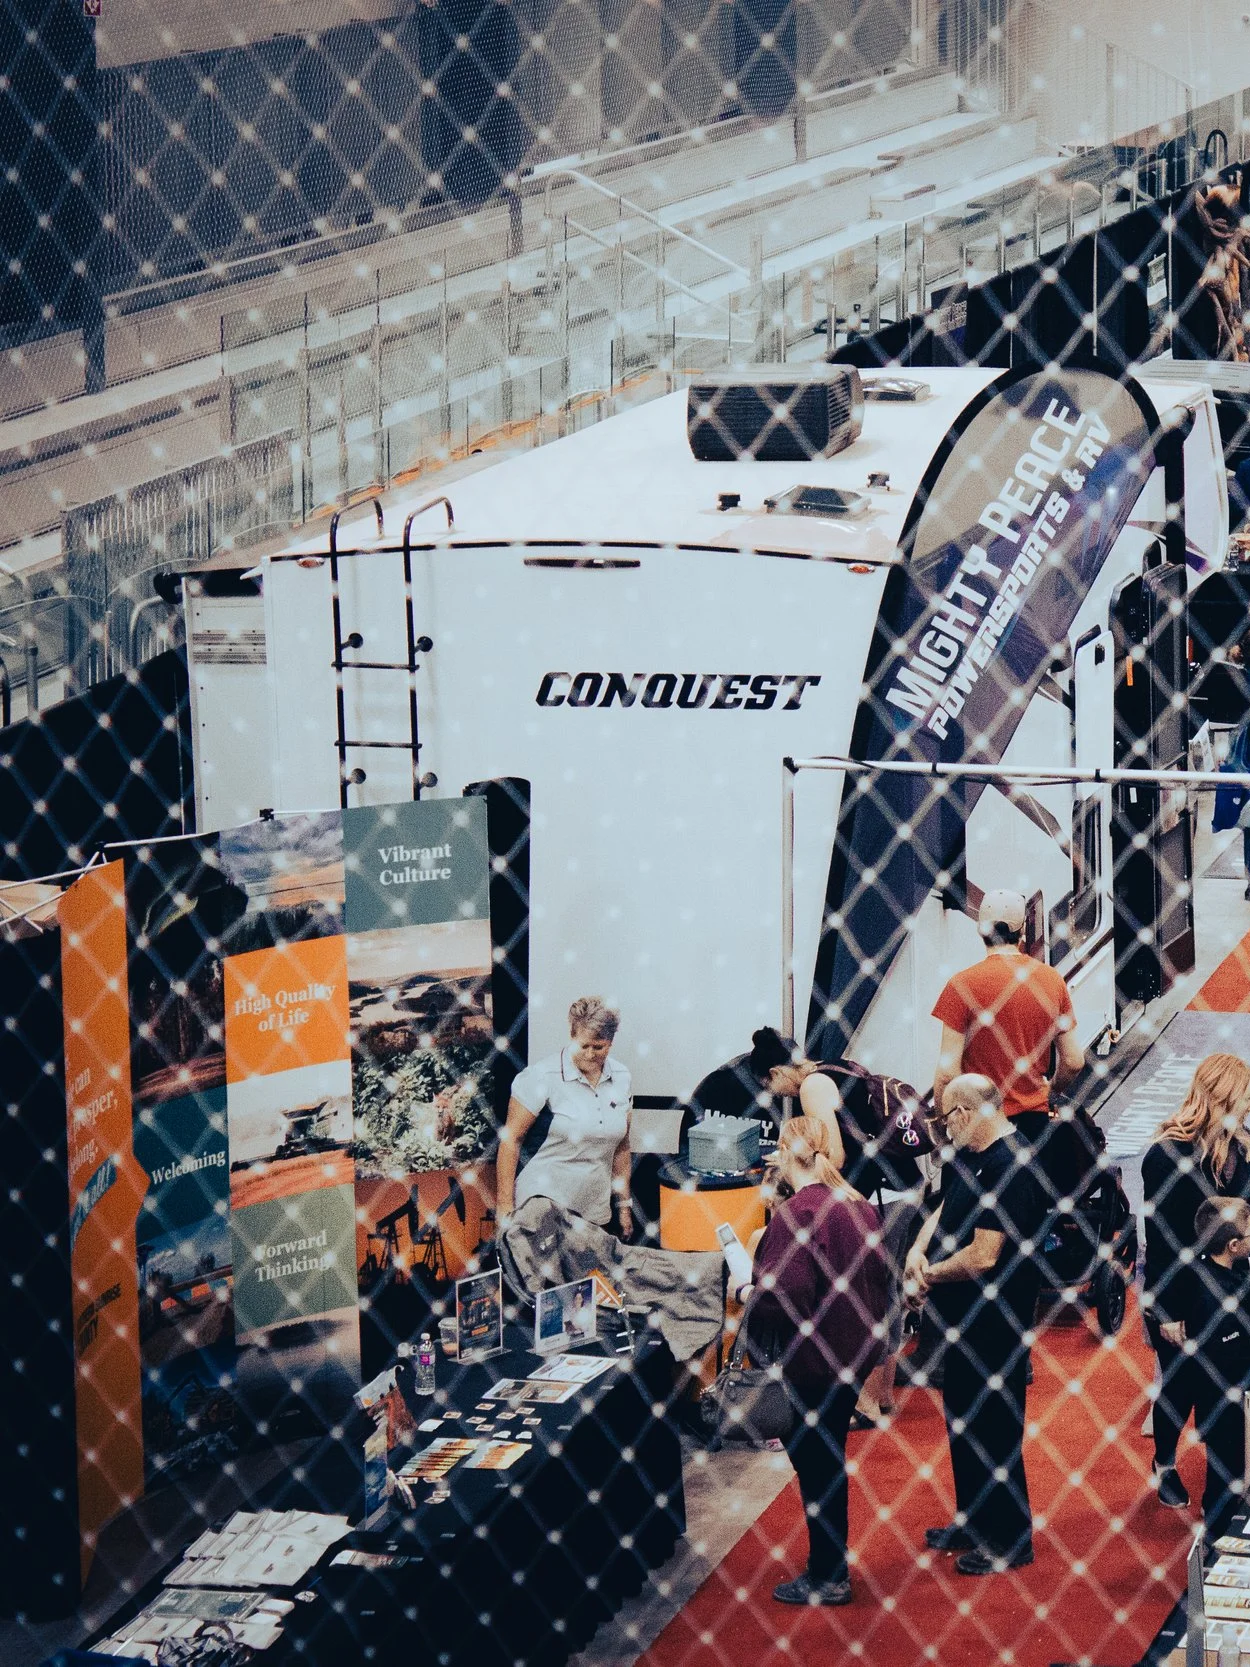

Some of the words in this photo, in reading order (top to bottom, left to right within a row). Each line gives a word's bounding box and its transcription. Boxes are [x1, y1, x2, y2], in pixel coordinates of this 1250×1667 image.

[884, 542, 1002, 721] MIGHTY
[981, 398, 1086, 544] PEACE
[927, 489, 1071, 740] POWERSPORTS
[1060, 464, 1086, 491] &
[1074, 415, 1110, 463] RV
[535, 671, 821, 711] CONQUEST
[378, 843, 451, 864] Vibrant
[379, 864, 451, 886] Culture
[234, 993, 272, 1018] High
[273, 980, 337, 1012] Quality
[258, 1012, 276, 1032] of
[278, 1008, 310, 1029] Life
[151, 1148, 226, 1186] Welcoming
[254, 1228, 328, 1262] Forward
[254, 1253, 330, 1283] Thinking
